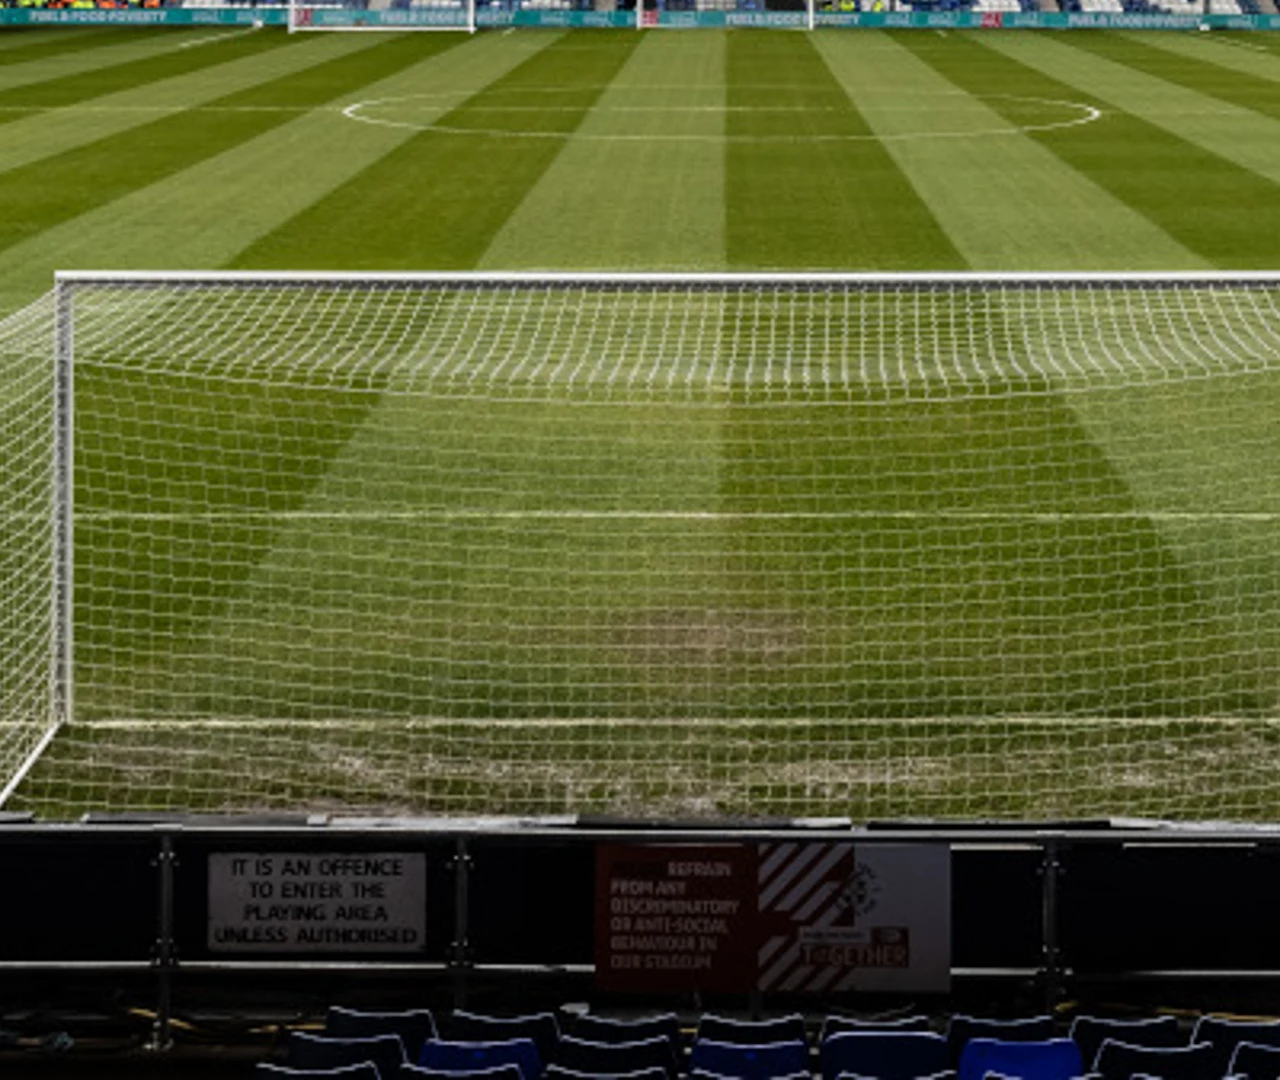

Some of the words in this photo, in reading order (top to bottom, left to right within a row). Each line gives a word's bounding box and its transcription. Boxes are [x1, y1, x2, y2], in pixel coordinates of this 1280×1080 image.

[232, 860, 247, 876] IT
[255, 859, 273, 876] IS
[282, 859, 311, 876] AN
[319, 859, 403, 876] OFFENCE
[667, 861, 731, 877] REFRAIN
[249, 882, 273, 898] TO
[281, 882, 343, 898] ENTER
[352, 882, 385, 898] THE
[610, 880, 653, 895] FROM
[655, 880, 686, 895] ANY
[244, 904, 325, 921] PLAYING
[335, 904, 389, 921] AREA
[610, 897, 740, 914] DISCRIMINATORY
[611, 916, 631, 932] OR
[634, 916, 730, 934] ANTI-SOCIAL
[214, 927, 287, 944] UNLESS
[297, 927, 417, 944] AUTHORISED
[610, 934, 695, 951] BEHAVIOUR
[699, 935, 718, 951] IN
[610, 953, 640, 968] OUR
[645, 953, 712, 968] STADIUM
